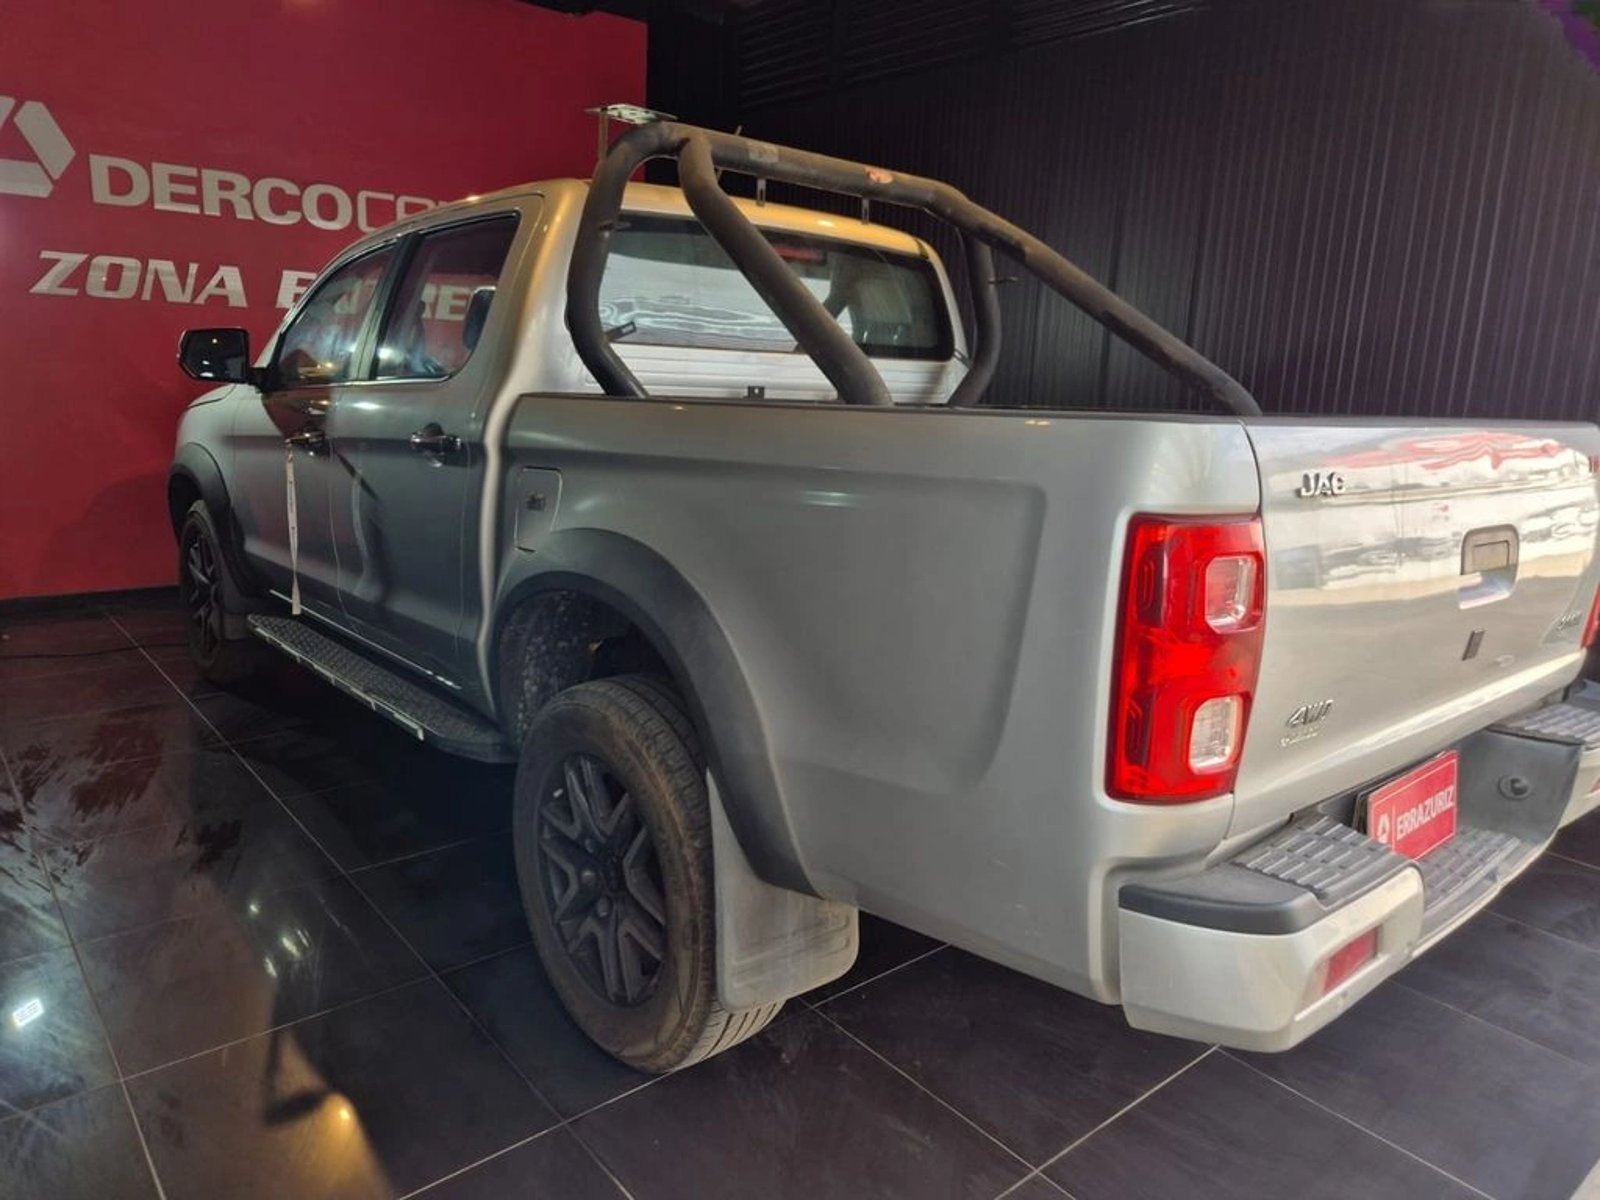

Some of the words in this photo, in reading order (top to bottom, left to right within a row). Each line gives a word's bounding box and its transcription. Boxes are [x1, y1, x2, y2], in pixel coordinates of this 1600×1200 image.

[29, 250, 248, 307] ZONA
[1296, 470, 1346, 498] JAC
[1396, 785, 1455, 841] ERRAZURIZ
